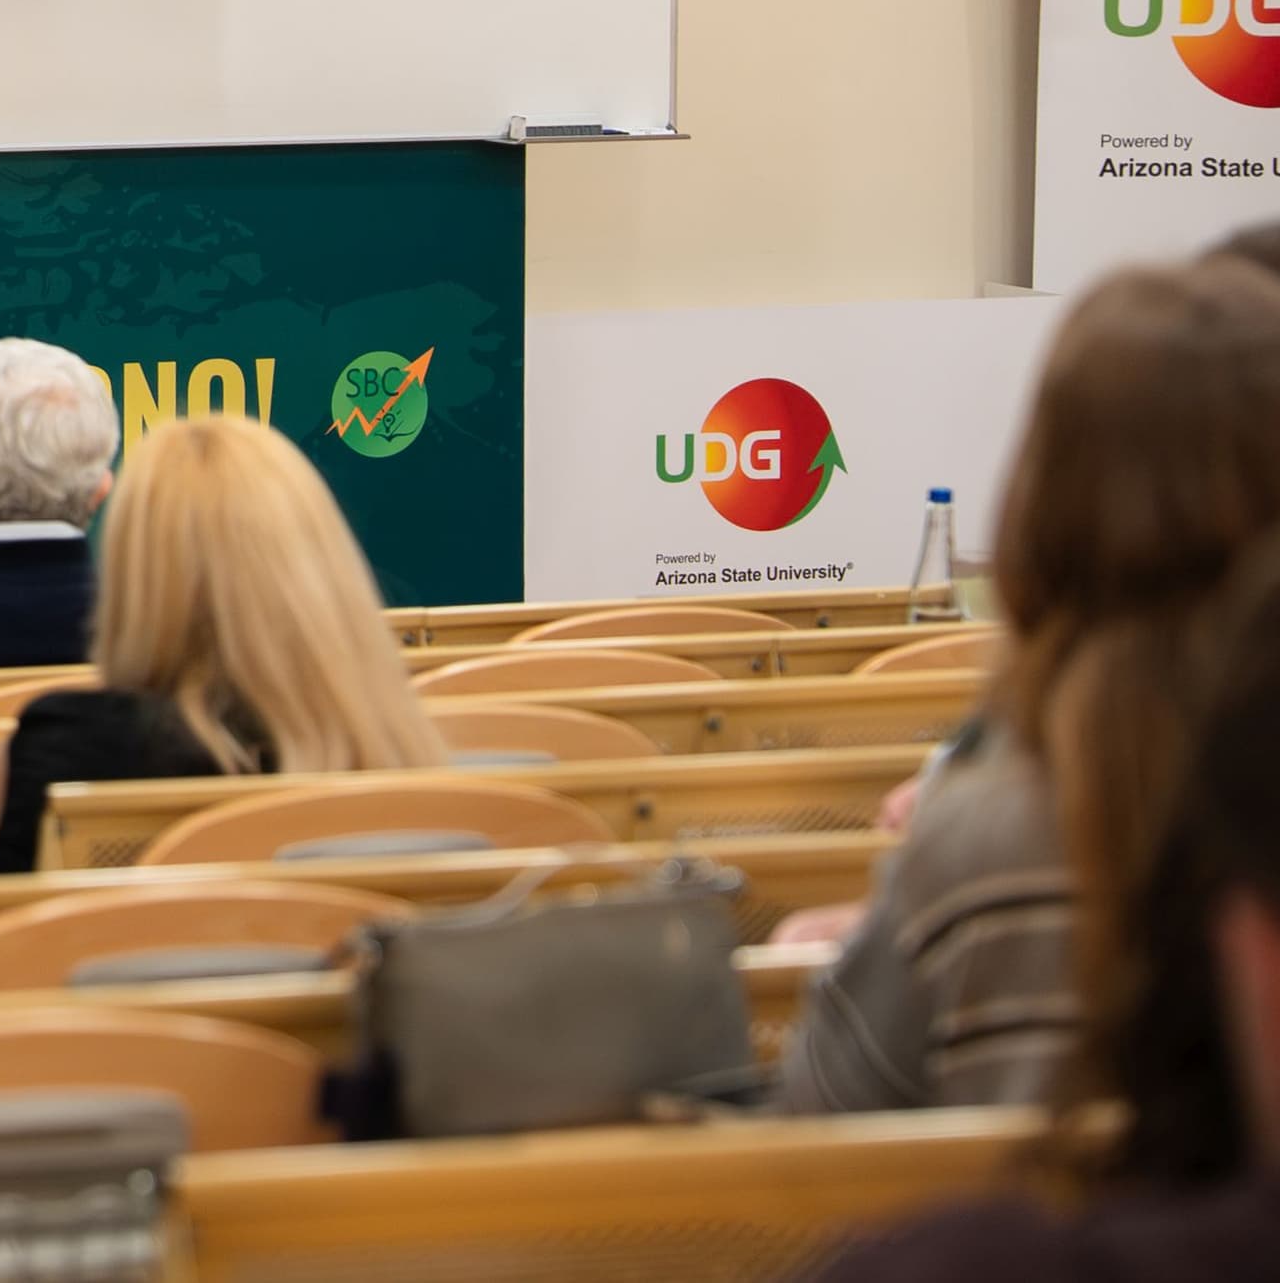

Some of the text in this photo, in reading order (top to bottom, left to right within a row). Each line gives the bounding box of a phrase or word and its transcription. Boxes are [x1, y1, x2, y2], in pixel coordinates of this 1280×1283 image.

[1100, 133, 1193, 151] Powered by
[1098, 157, 1193, 178] Arizona
[1201, 156, 1265, 178] State
[345, 366, 402, 398] SBC
[655, 429, 781, 484] UDG
[655, 551, 717, 565] Powered by
[655, 570, 717, 586] Arizona
[721, 567, 762, 583] State
